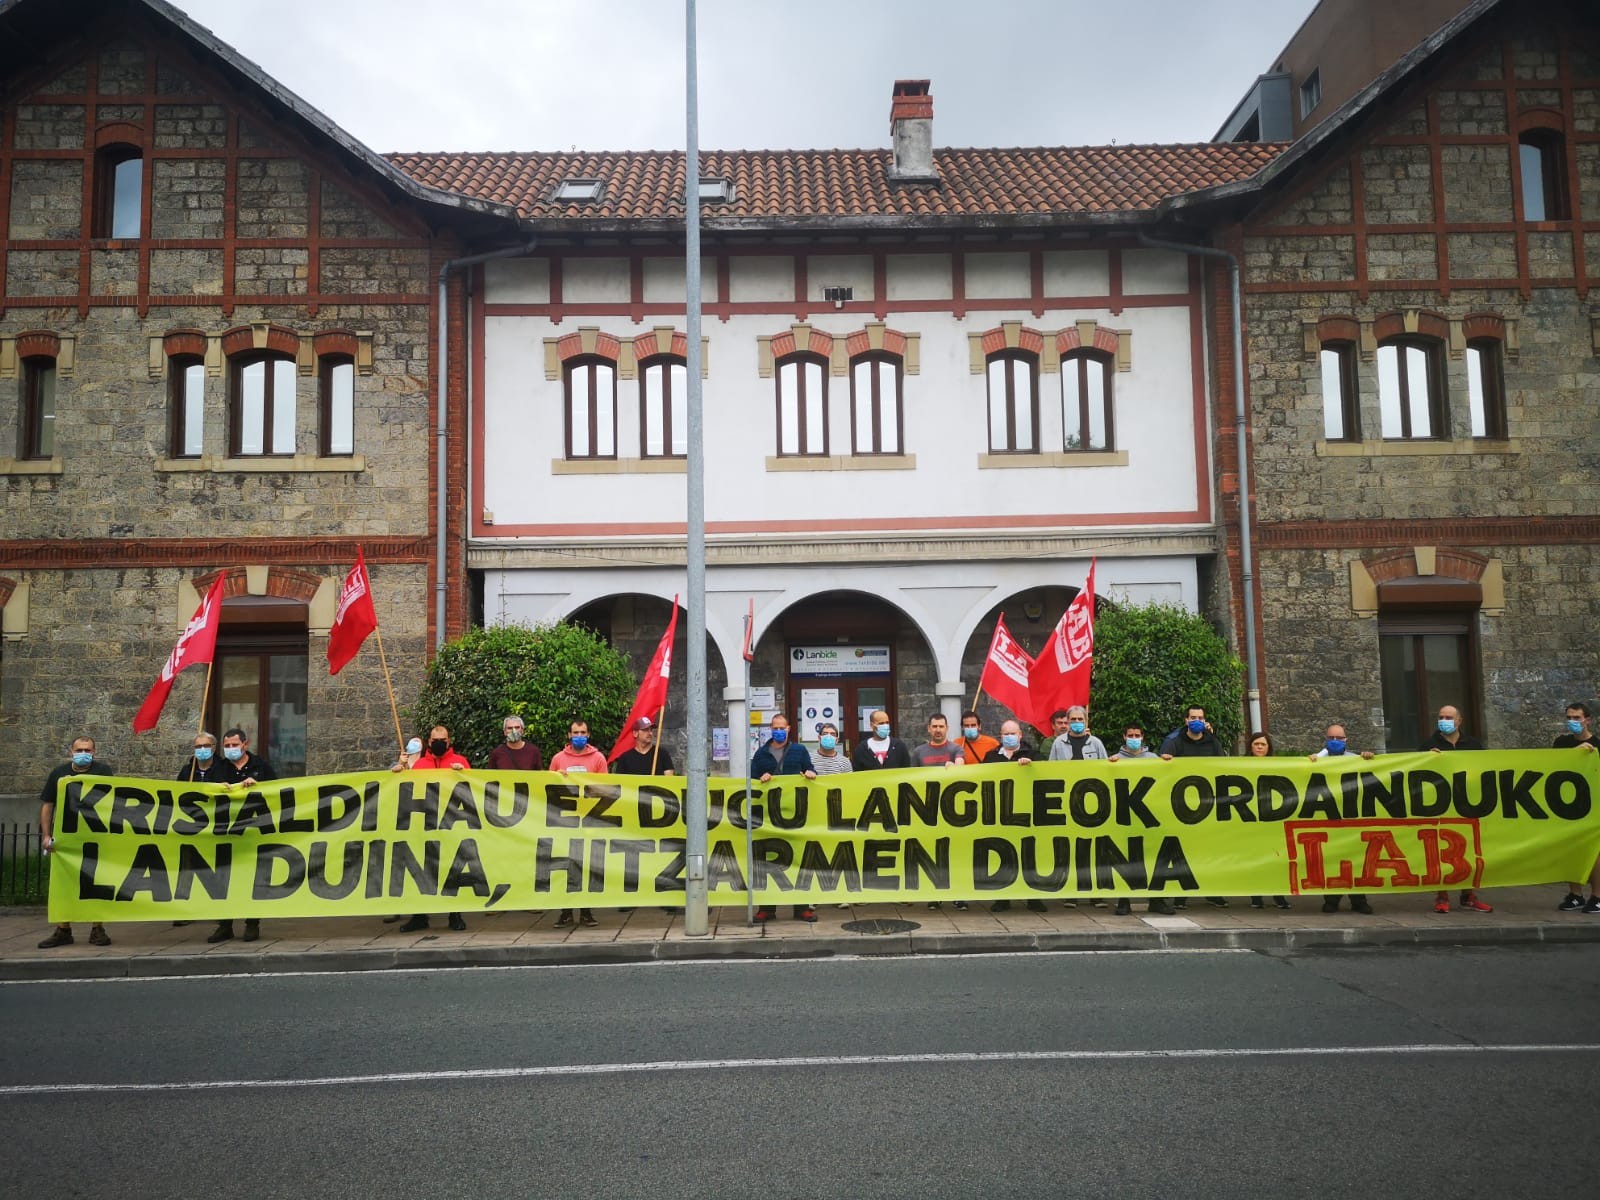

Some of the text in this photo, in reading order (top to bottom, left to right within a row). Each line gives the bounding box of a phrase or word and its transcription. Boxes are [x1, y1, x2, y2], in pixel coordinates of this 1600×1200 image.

[806, 650, 838, 659] Lanbide
[62, 780, 380, 835] KRISIALDI
[396, 780, 529, 831] HAU
[545, 784, 623, 828] EZ
[826, 778, 1161, 833] LANGILEOK
[1171, 769, 1592, 825] ORDAINDUKO
[79, 835, 1200, 907] LAN DUINA, HITZARMEN DUINA
[1297, 828, 1473, 889] LAB
